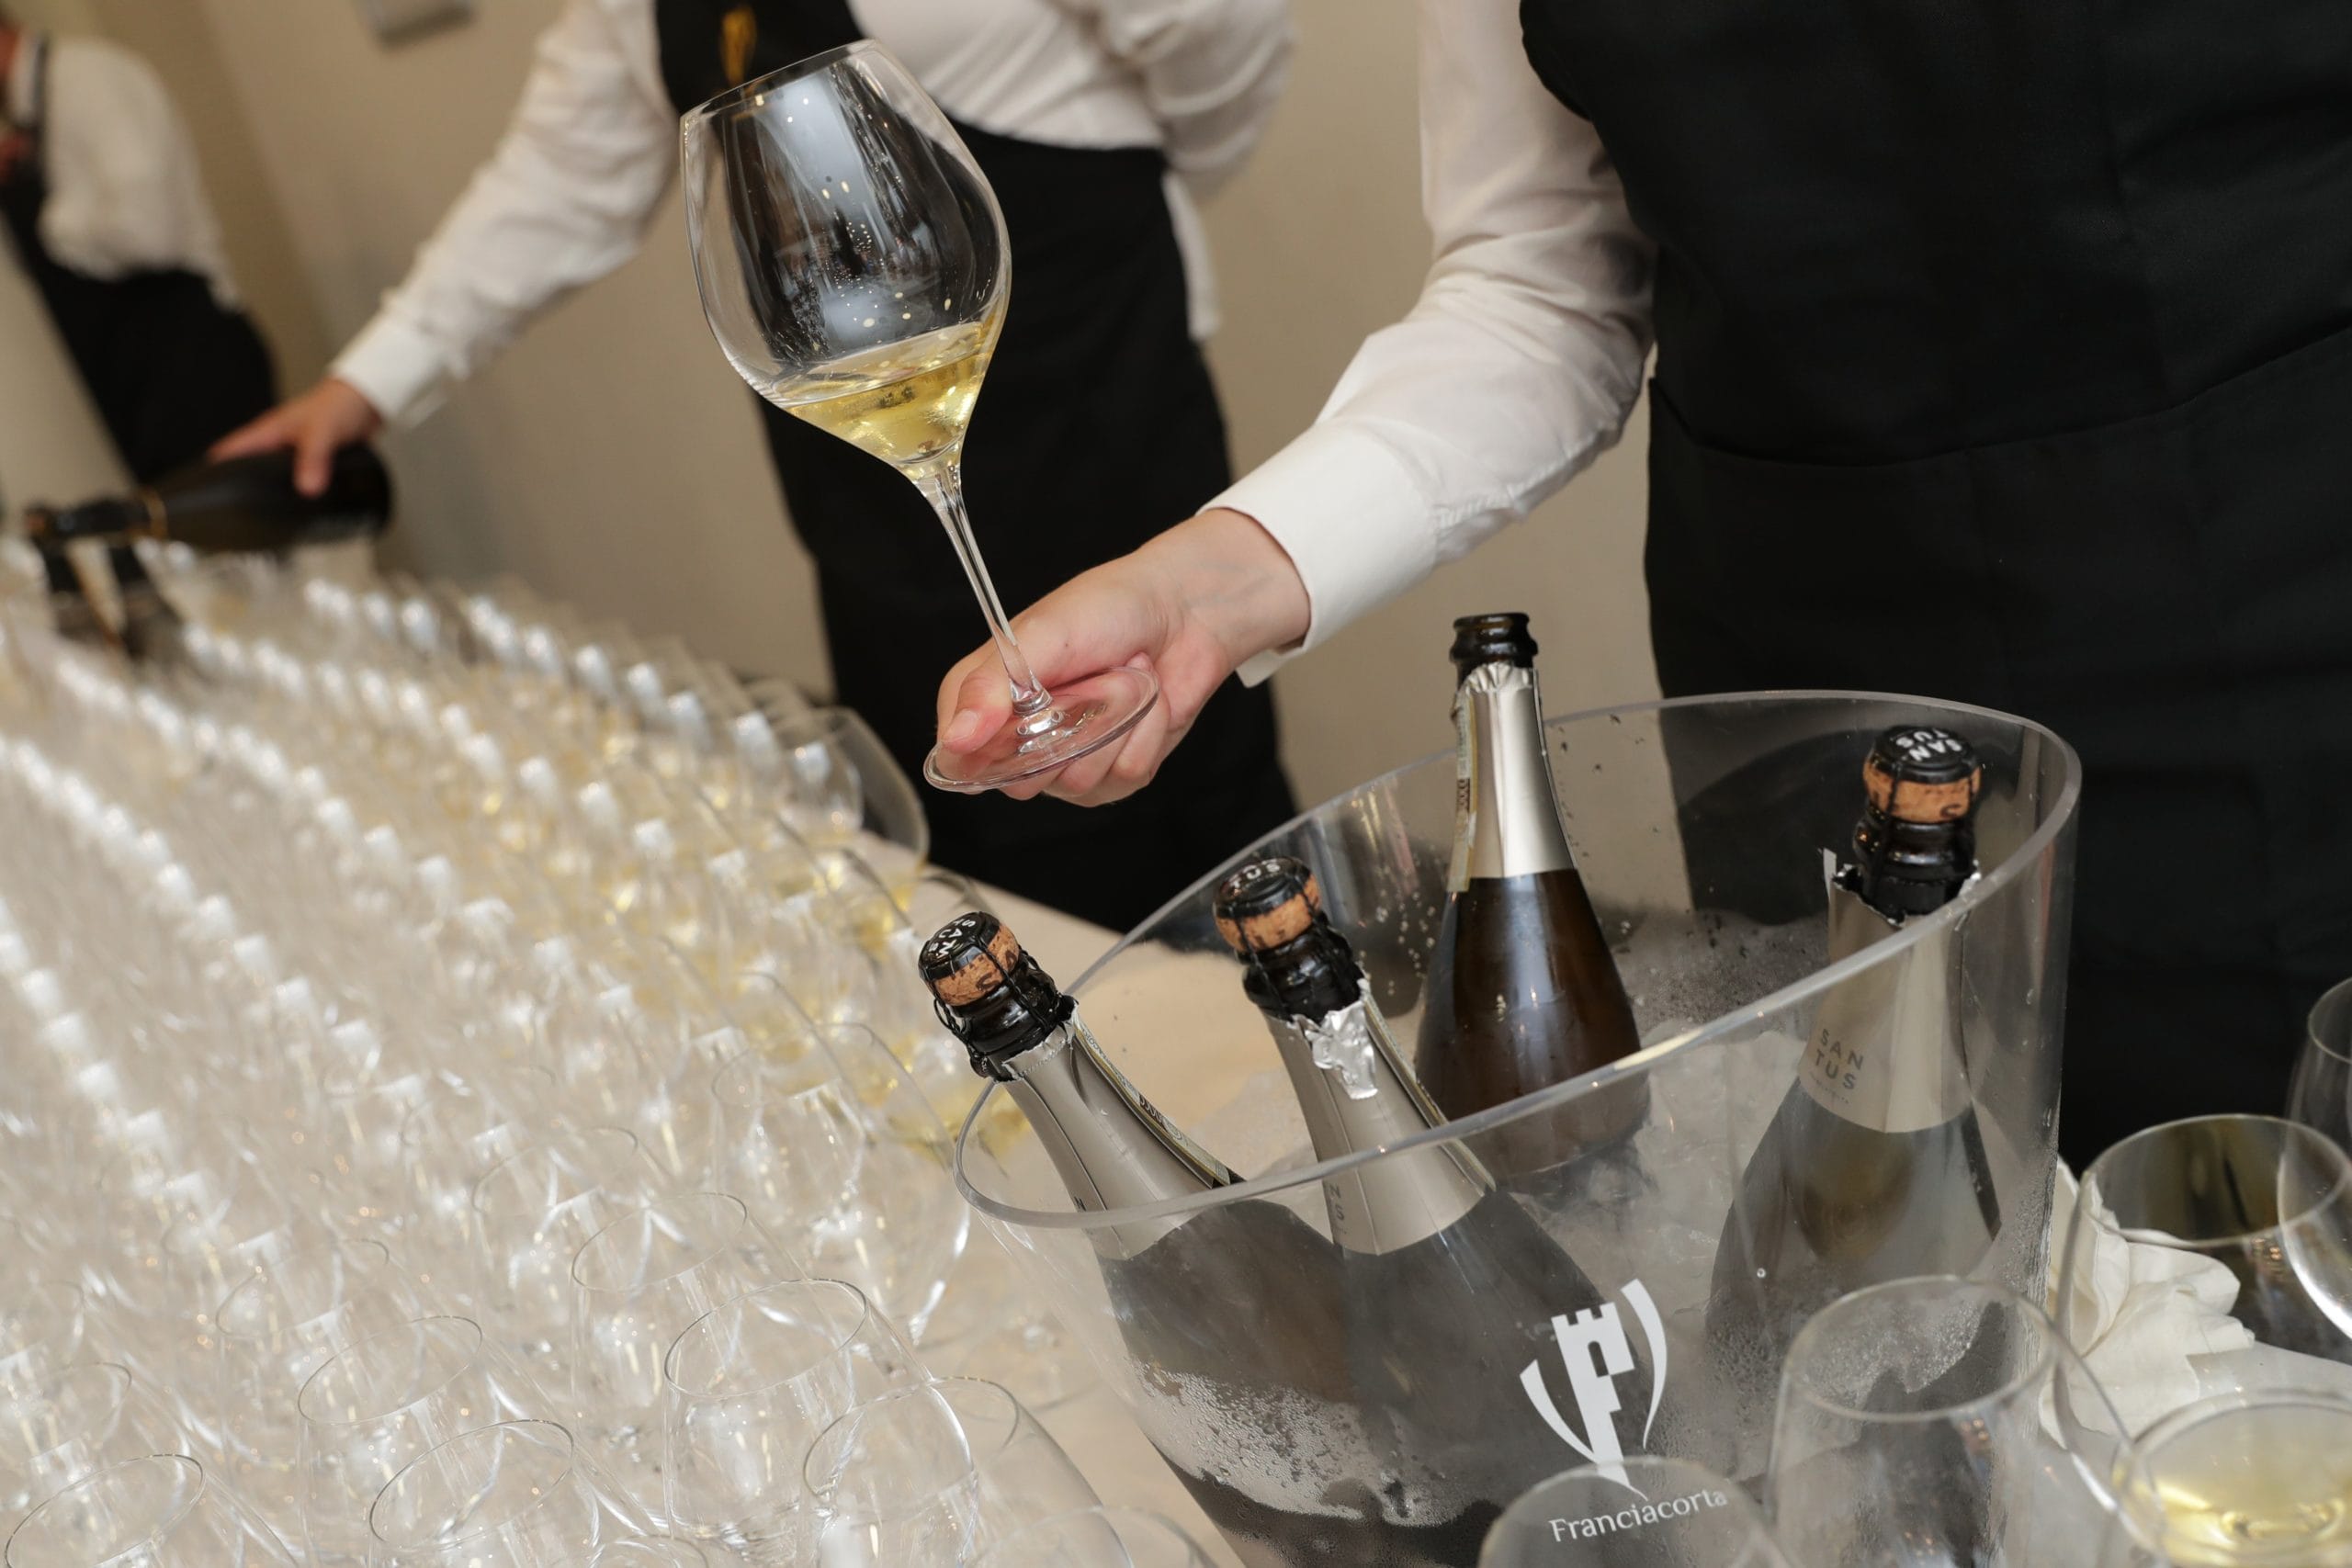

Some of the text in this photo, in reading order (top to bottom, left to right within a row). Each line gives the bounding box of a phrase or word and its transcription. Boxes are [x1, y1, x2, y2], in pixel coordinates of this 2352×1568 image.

[1815, 1048, 1857, 1089] TUS
[1820, 1028, 1864, 1070] SAN
[1548, 1489, 1728, 1542] Franciacorta
